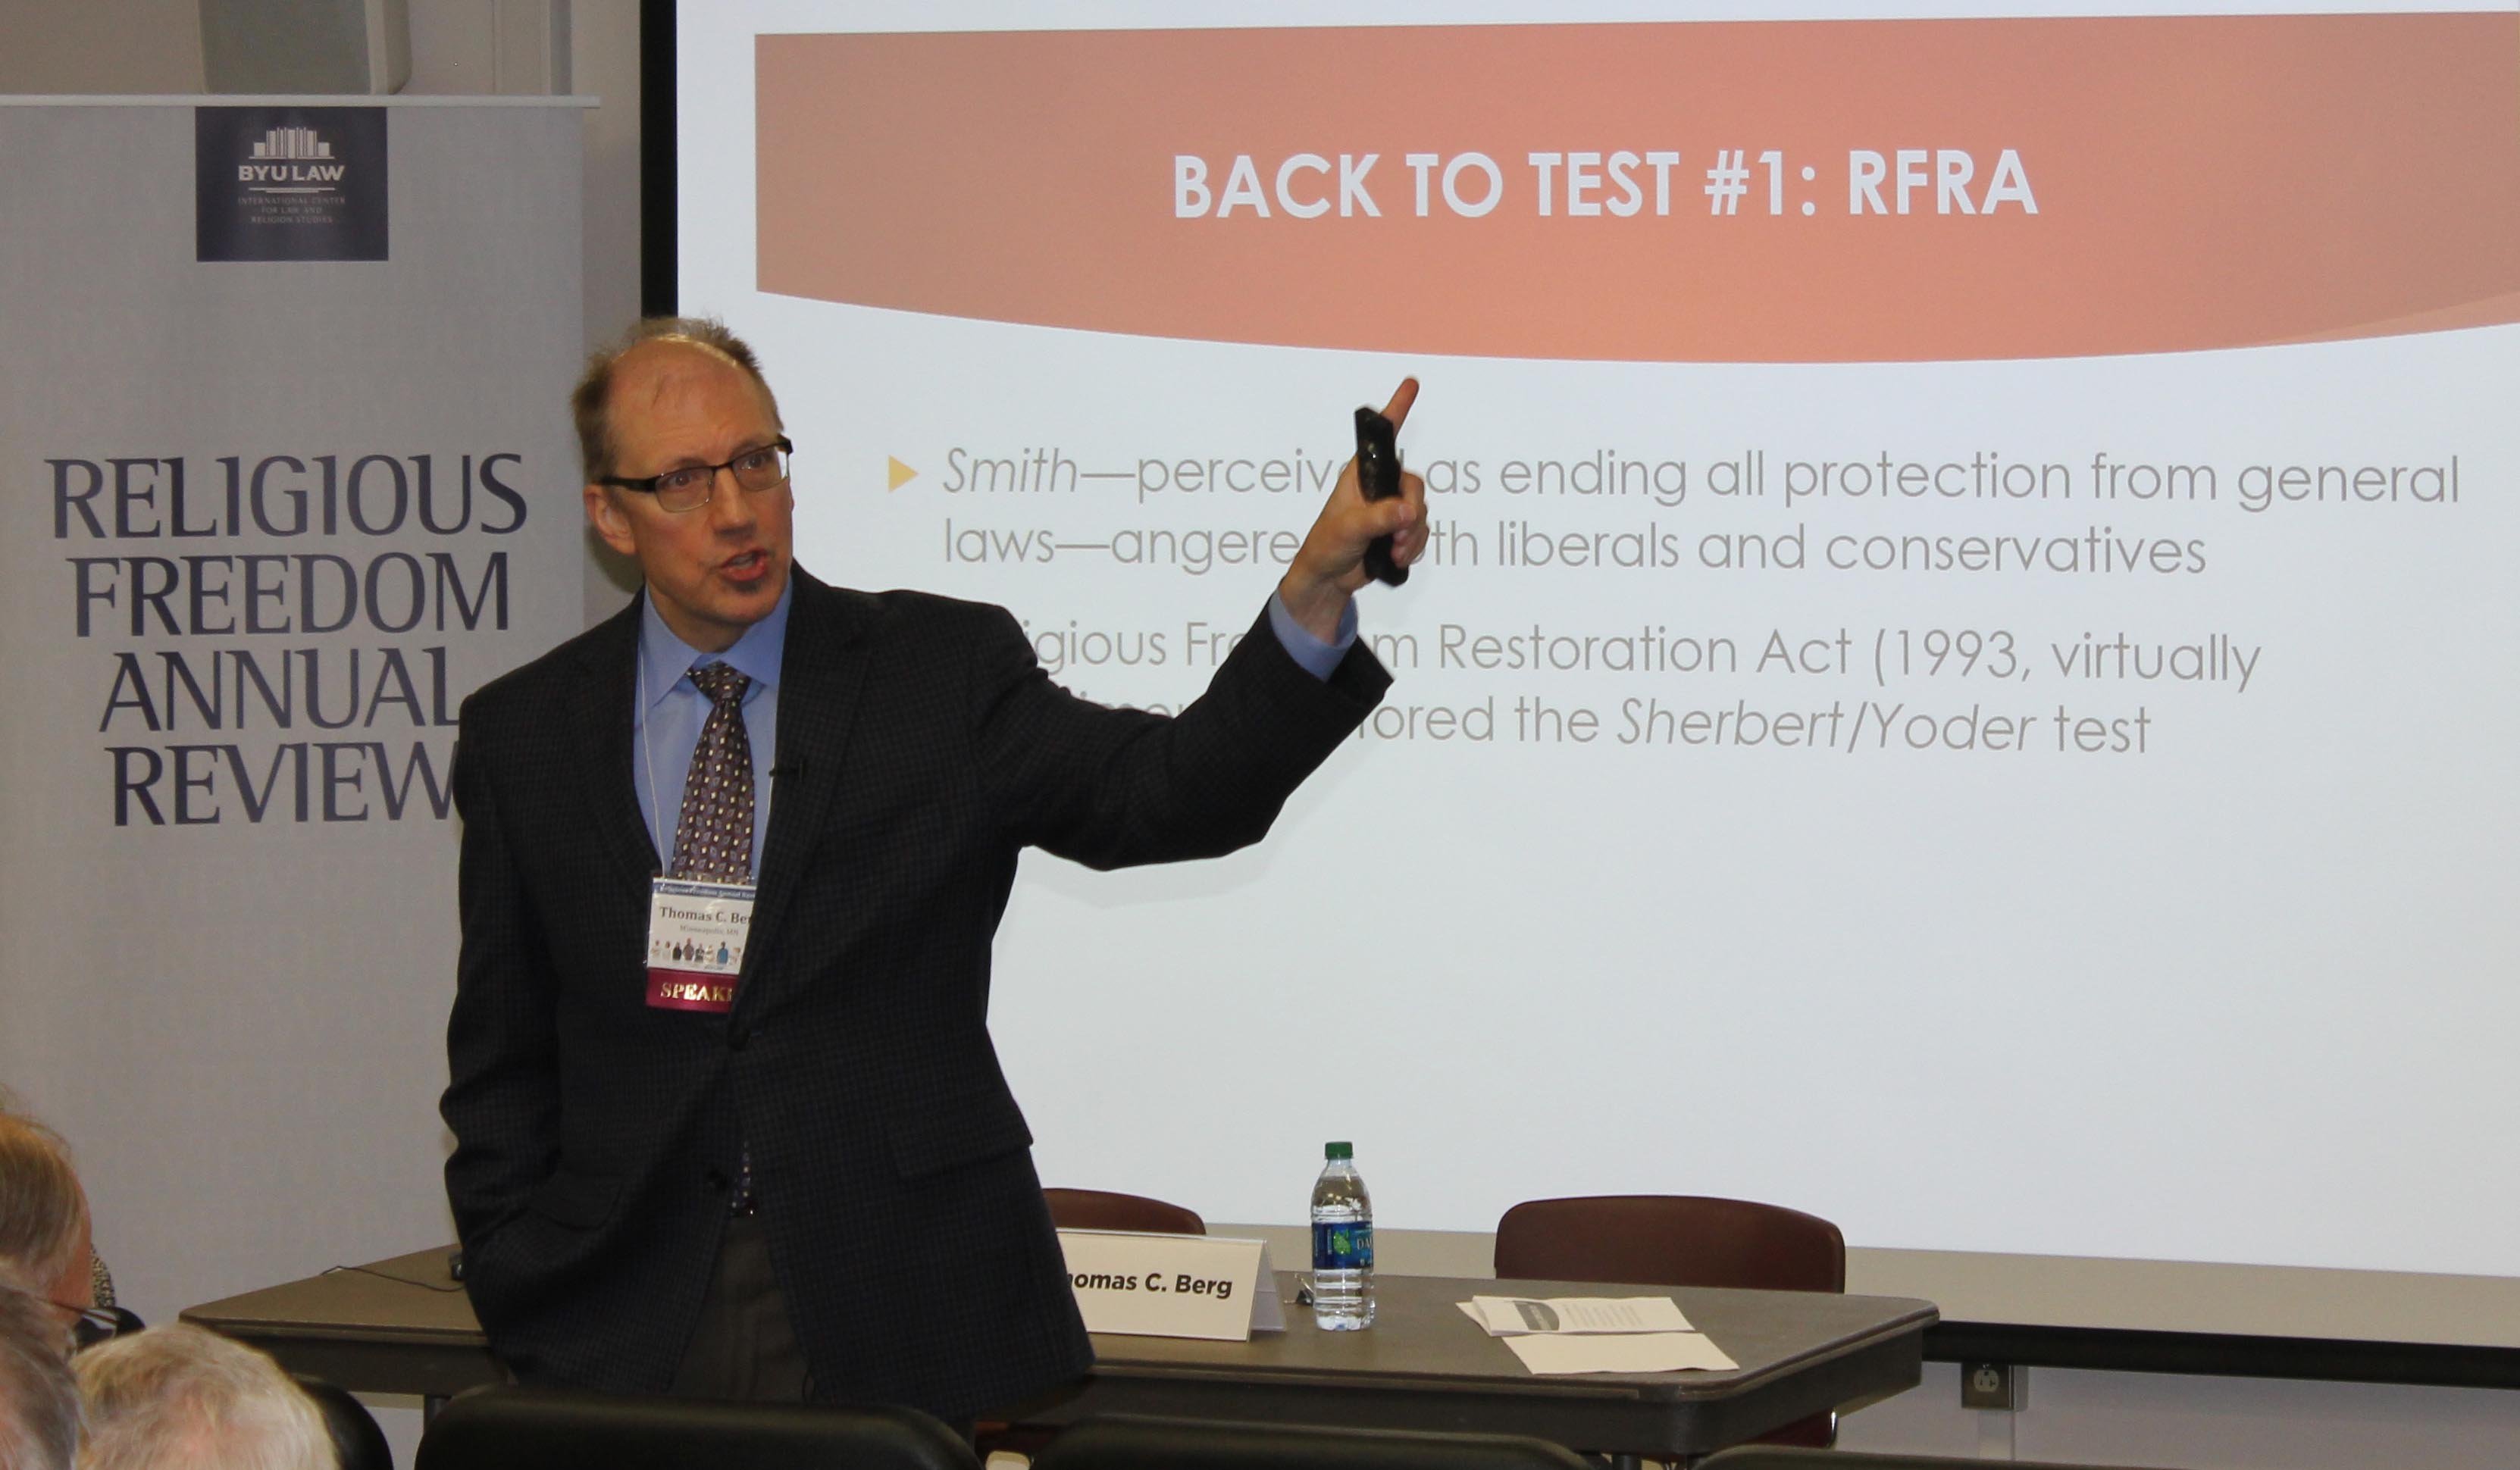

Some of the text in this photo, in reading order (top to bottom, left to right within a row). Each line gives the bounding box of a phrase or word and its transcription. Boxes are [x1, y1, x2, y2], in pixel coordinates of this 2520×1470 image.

[239, 165, 345, 181] BYU LAW
[1175, 149, 2039, 219] BACK TO TEST #1: RFRA
[44, 453, 527, 539] RELIGIOUS
[943, 448, 2459, 513] Smith—perceiv as ending all protection from general
[945, 518, 1300, 574] laws—angere
[1499, 521, 1679, 568] liberals
[1699, 523, 1805, 570] and
[1826, 526, 2207, 575] conservatives
[66, 551, 509, 636] FREEDOM
[99, 646, 459, 732] ANNUAL
[1441, 624, 1737, 673] Restoration
[1756, 628, 1853, 674] Act
[1874, 628, 2031, 687] (1993,
[2052, 631, 2262, 693] virtually
[1514, 696, 1600, 743] the
[1617, 697, 2039, 753] Sherbert/Yoder
[2054, 705, 2152, 753] test
[660, 907, 712, 921] Thomas
[731, 912, 750, 924] Be
[660, 982, 732, 1002] SPEAK
[1145, 1273, 1168, 1293] C.
[1175, 1275, 1234, 1300] Berg
